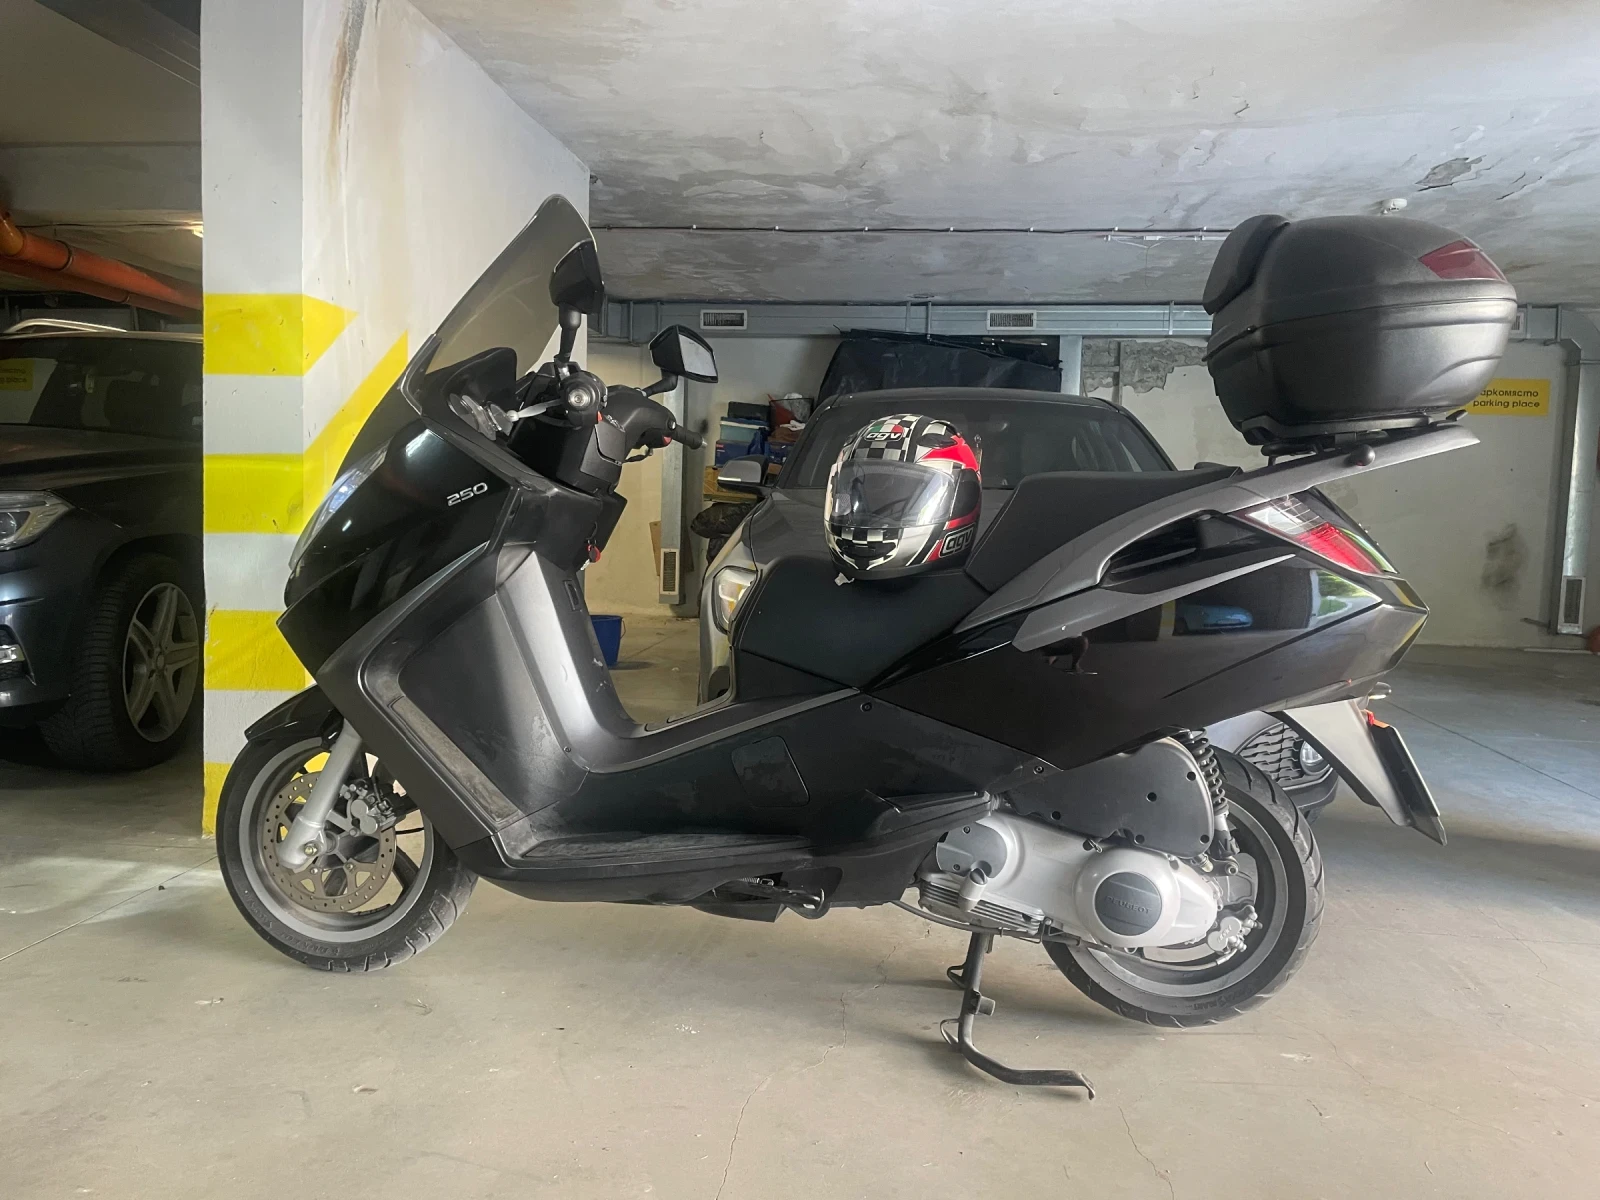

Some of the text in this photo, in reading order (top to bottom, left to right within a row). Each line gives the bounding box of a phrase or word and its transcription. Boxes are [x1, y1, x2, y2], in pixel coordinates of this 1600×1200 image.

[1480, 388, 1539, 398] аркомясто
[1473, 399, 1540, 408] parking place
[446, 482, 488, 507] 250
[1104, 895, 1152, 914] PEUGEOT
